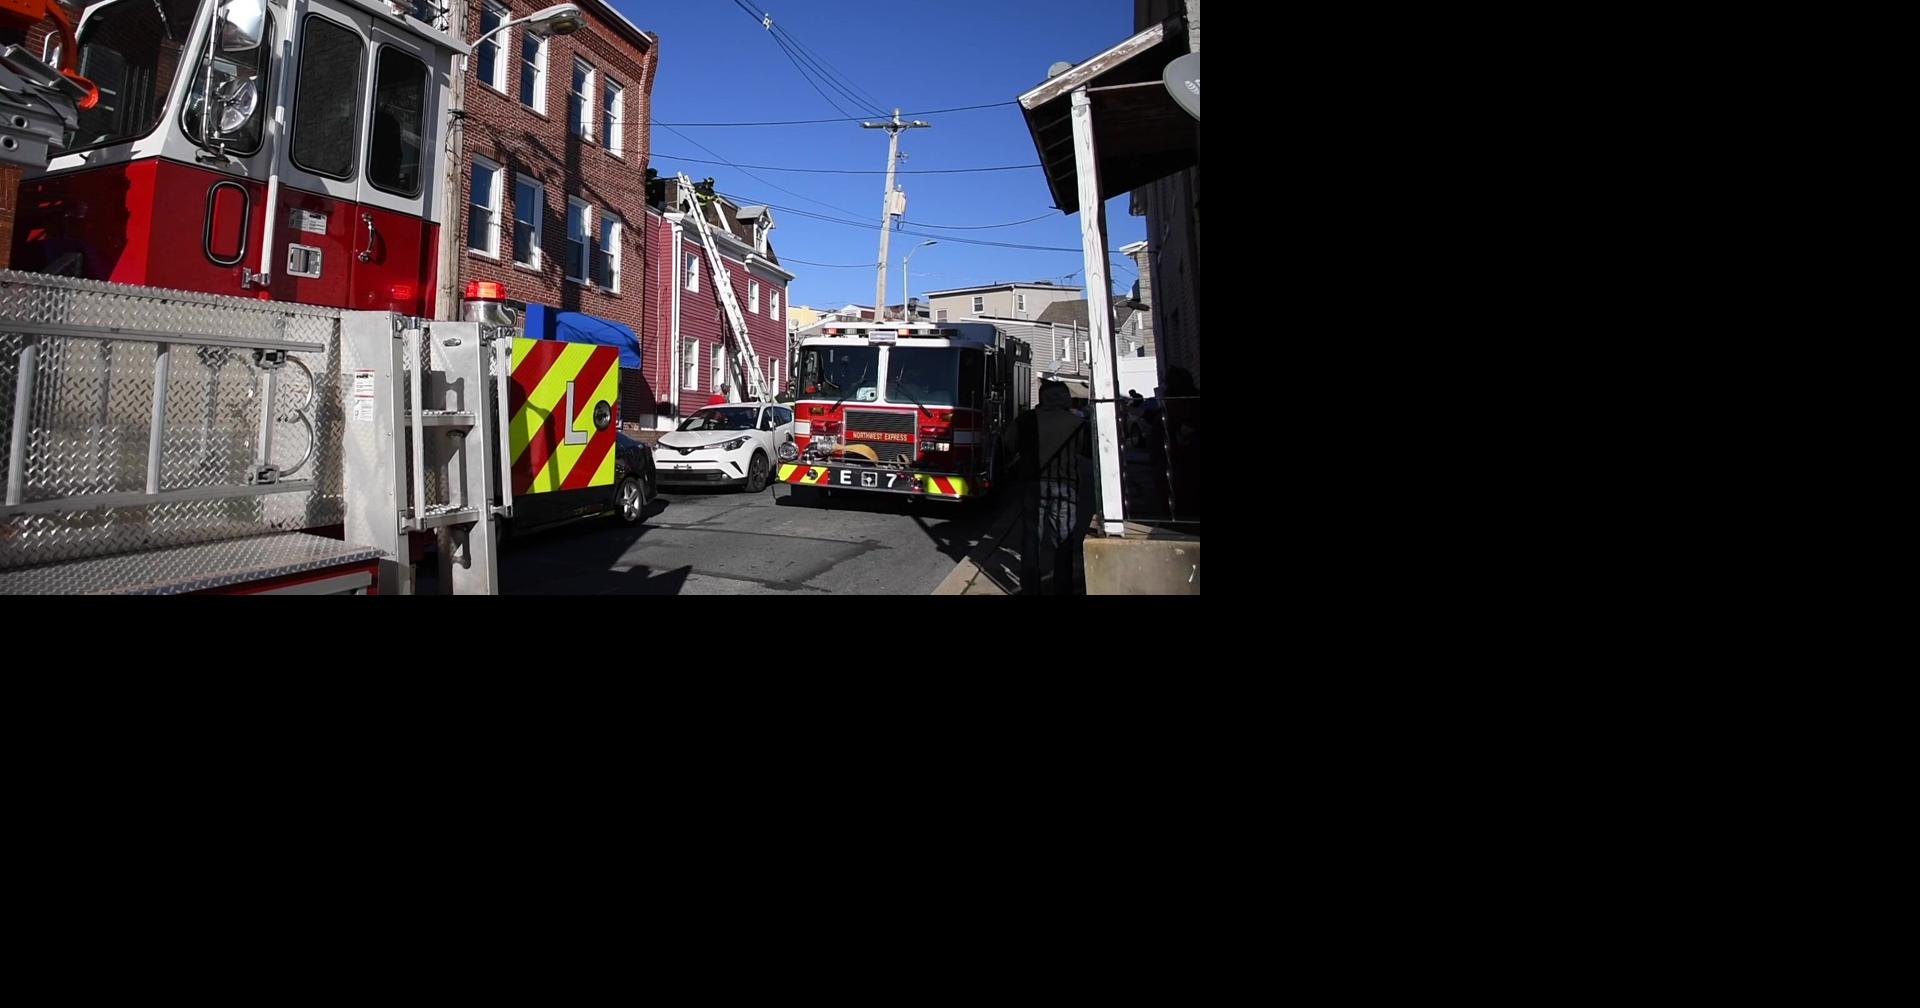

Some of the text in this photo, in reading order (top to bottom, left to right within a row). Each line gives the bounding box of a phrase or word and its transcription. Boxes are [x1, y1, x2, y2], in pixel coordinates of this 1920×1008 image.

[564, 381, 588, 445] L
[852, 431, 908, 441] NORTHWEST EXPRESS
[840, 470, 897, 488] E 7
